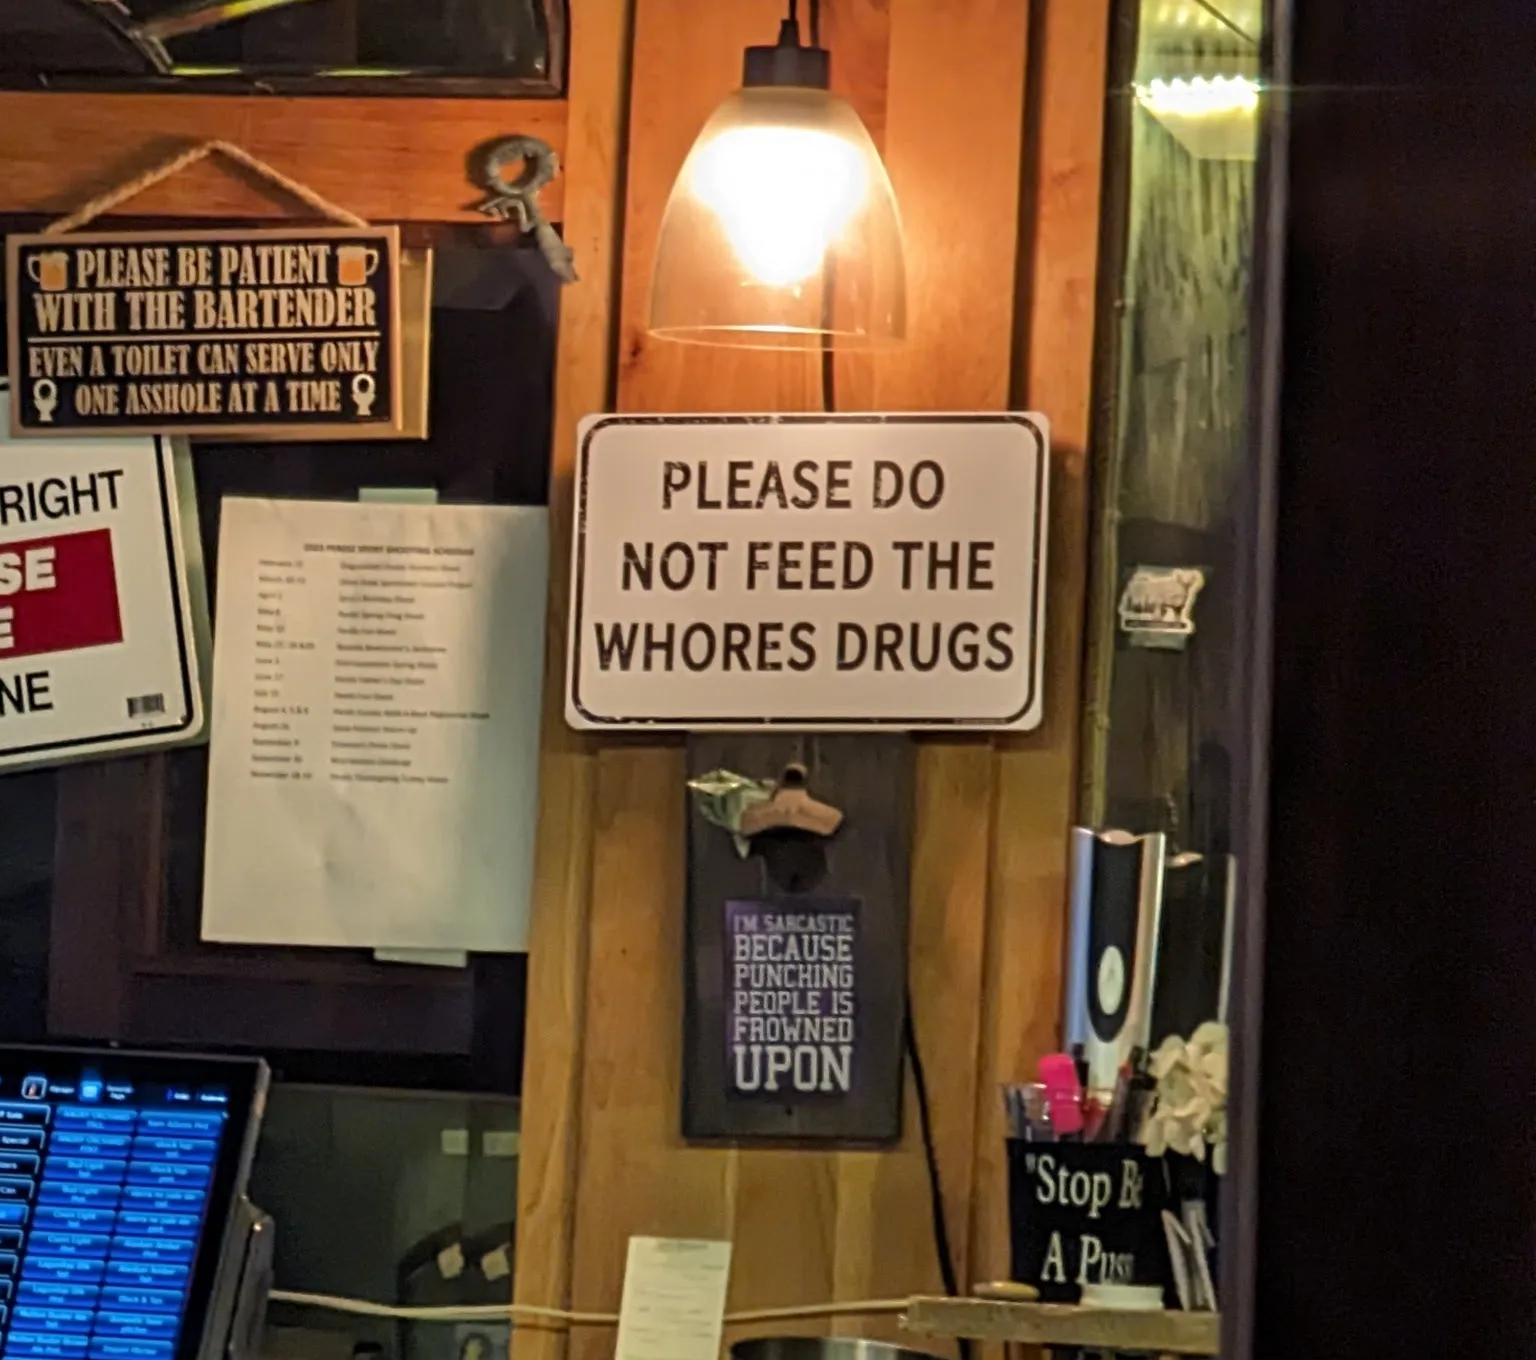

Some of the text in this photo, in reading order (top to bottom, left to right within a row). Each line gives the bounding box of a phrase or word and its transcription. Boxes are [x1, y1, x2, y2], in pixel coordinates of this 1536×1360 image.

[75, 245, 331, 290] PLEASE BE PATIENT
[33, 286, 377, 333] WITH THE BARTENDER
[28, 341, 380, 378] EVEN A TOILET CAN SERVE ONLY
[75, 380, 341, 416] ONE ASSHOLE AT A TIME
[662, 460, 944, 510] PLEASE DO
[621, 541, 995, 591] NOT FEED THE
[594, 622, 1014, 672] WHORES DRUGS
[734, 914, 854, 933] I'M SARCASTIC
[734, 934, 854, 961] BECAUSE
[734, 964, 854, 989] PUNCHING
[734, 991, 854, 1015] PEOPLE IS
[734, 1017, 854, 1042] FROWNED
[733, 1044, 853, 1091] UPON
[1040, 1230, 1067, 1283] A
